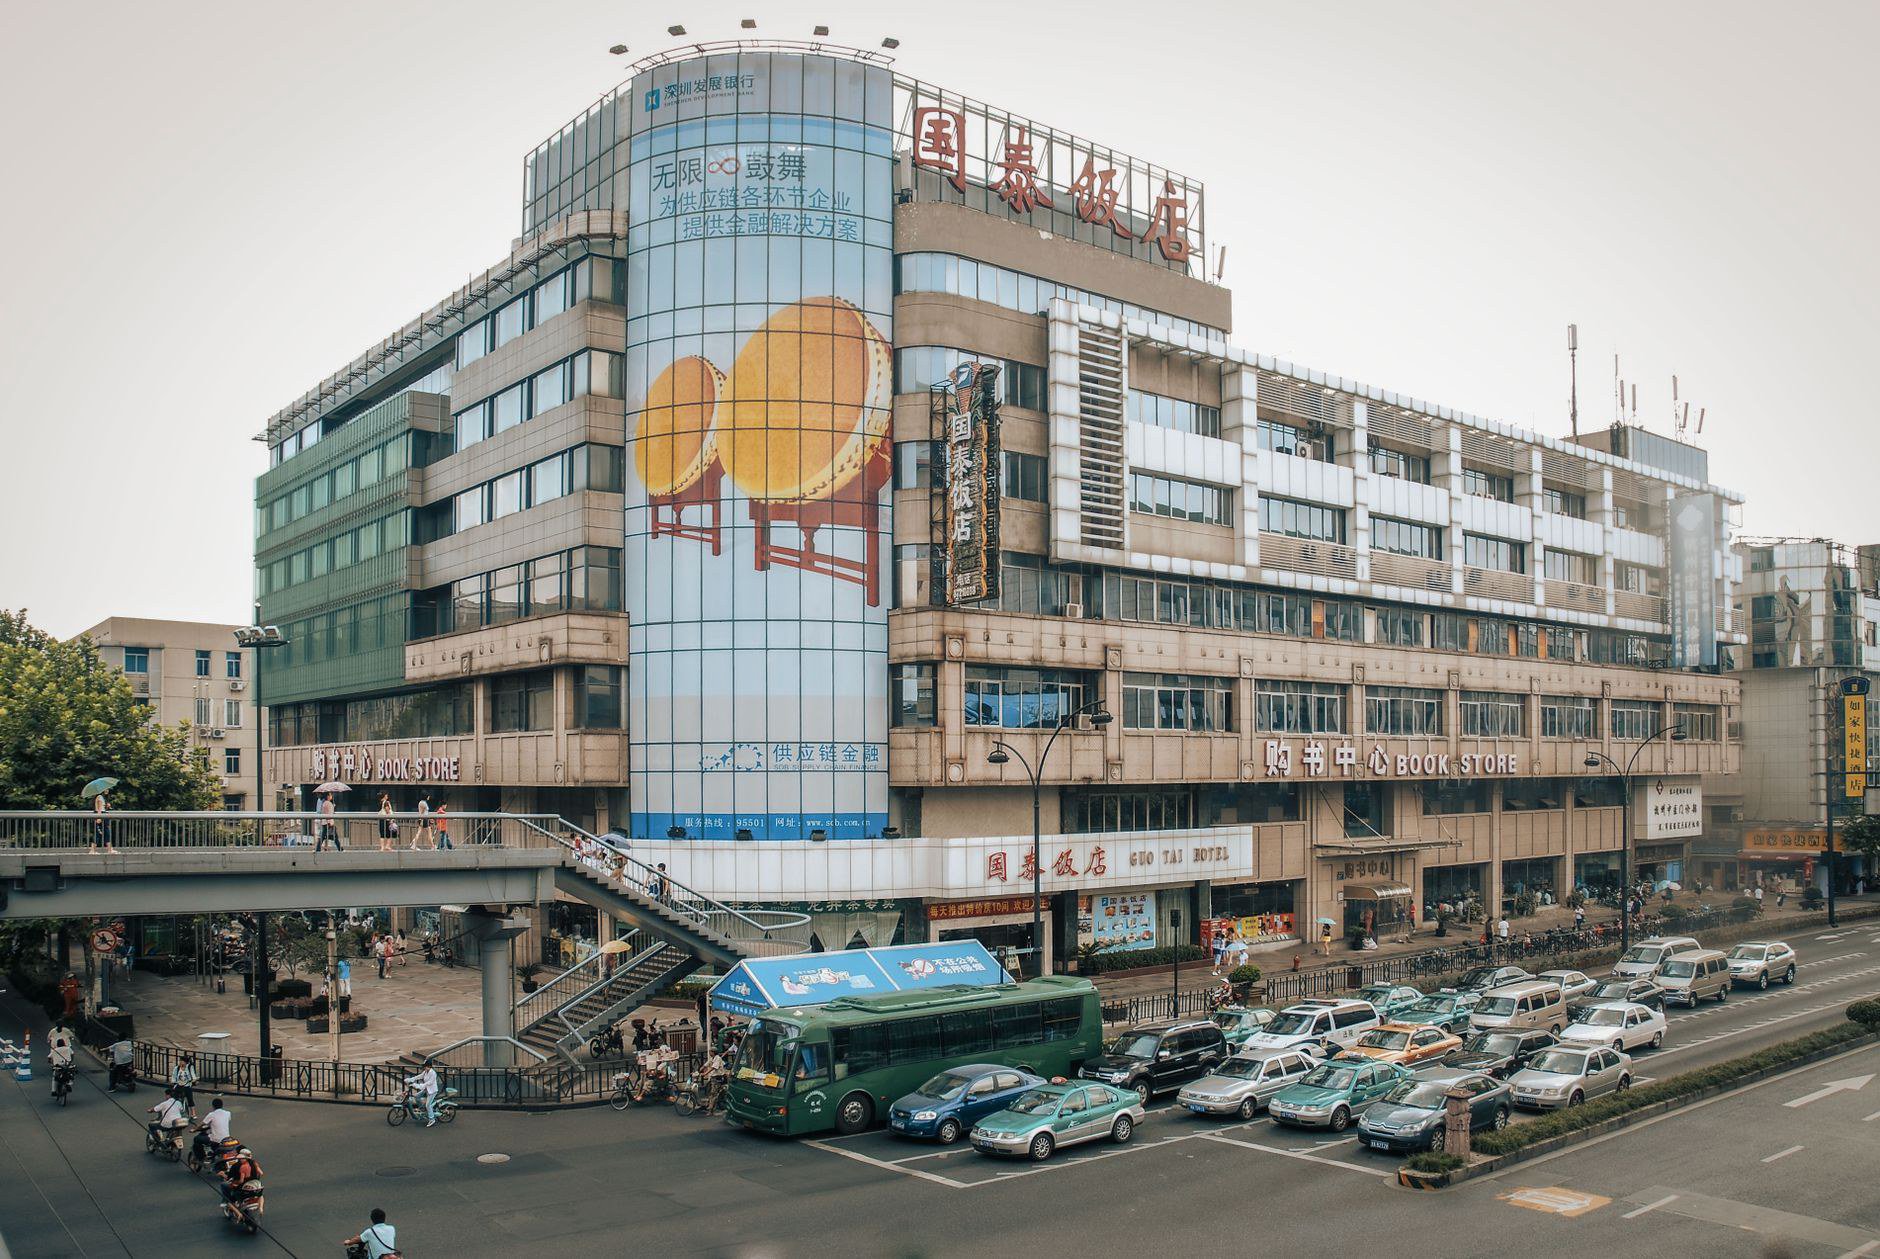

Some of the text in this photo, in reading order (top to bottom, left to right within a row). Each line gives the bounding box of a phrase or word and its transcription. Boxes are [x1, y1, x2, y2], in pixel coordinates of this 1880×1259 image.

[664, 75, 755, 100] 深圳发展银行
[659, 186, 852, 216] 为供应链各环节企业
[914, 107, 1192, 263] 国泰饭店
[683, 212, 858, 240] 提供金融解决方案
[952, 411, 974, 542] 国泰饭店
[773, 743, 879, 762] 供应链金融
[1265, 741, 1518, 776] 购书中心 BOOK STORE
[1849, 700, 1861, 791] 如家快捷酒店
[313, 748, 460, 780] 购书中心 BOOK STORE
[987, 845, 1230, 882] 国泰饭店 GUO TAI HOTEL
